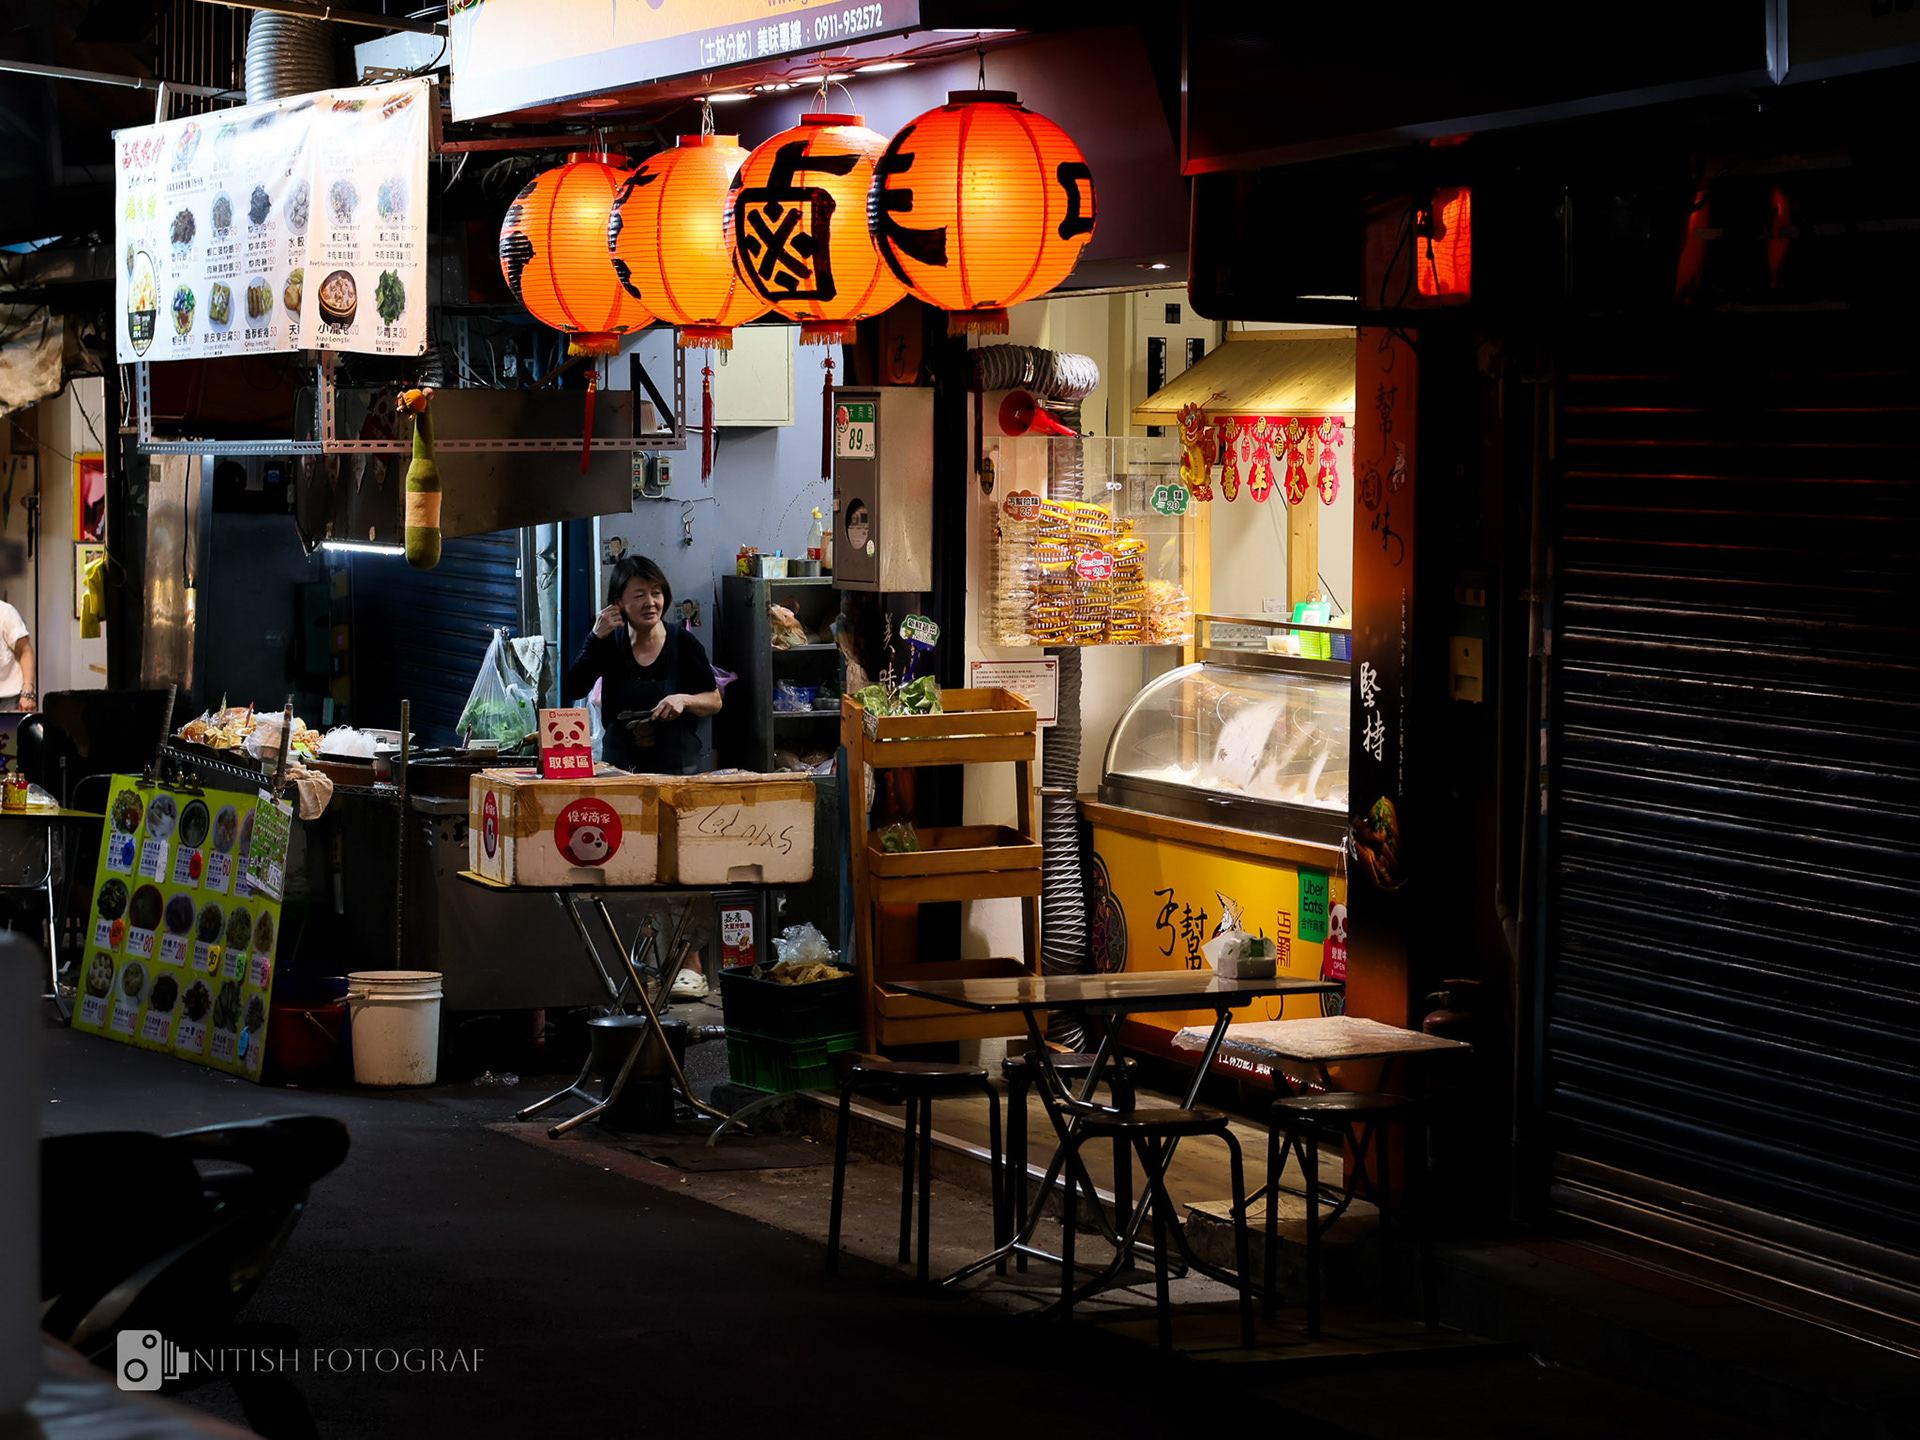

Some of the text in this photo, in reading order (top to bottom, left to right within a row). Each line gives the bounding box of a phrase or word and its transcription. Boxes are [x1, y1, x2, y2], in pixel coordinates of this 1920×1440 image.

[814, 3, 883, 41] 0911-952572
[267, 238, 276, 248] 150
[267, 255, 276, 265] 150
[233, 329, 241, 341] 50
[270, 326, 278, 338] 50
[288, 324, 300, 336] 天
[398, 327, 408, 339] 80
[848, 427, 864, 451] 89
[1020, 507, 1033, 517] 25
[1167, 501, 1180, 511] 20
[1093, 567, 1105, 576] 20
[548, 755, 590, 770] 取餐區
[567, 811, 611, 825] 優質商家
[1303, 879, 1324, 897] Uber
[1303, 897, 1324, 915] Eats
[143, 935, 154, 953] 80
[1333, 961, 1346, 971] OPEN
